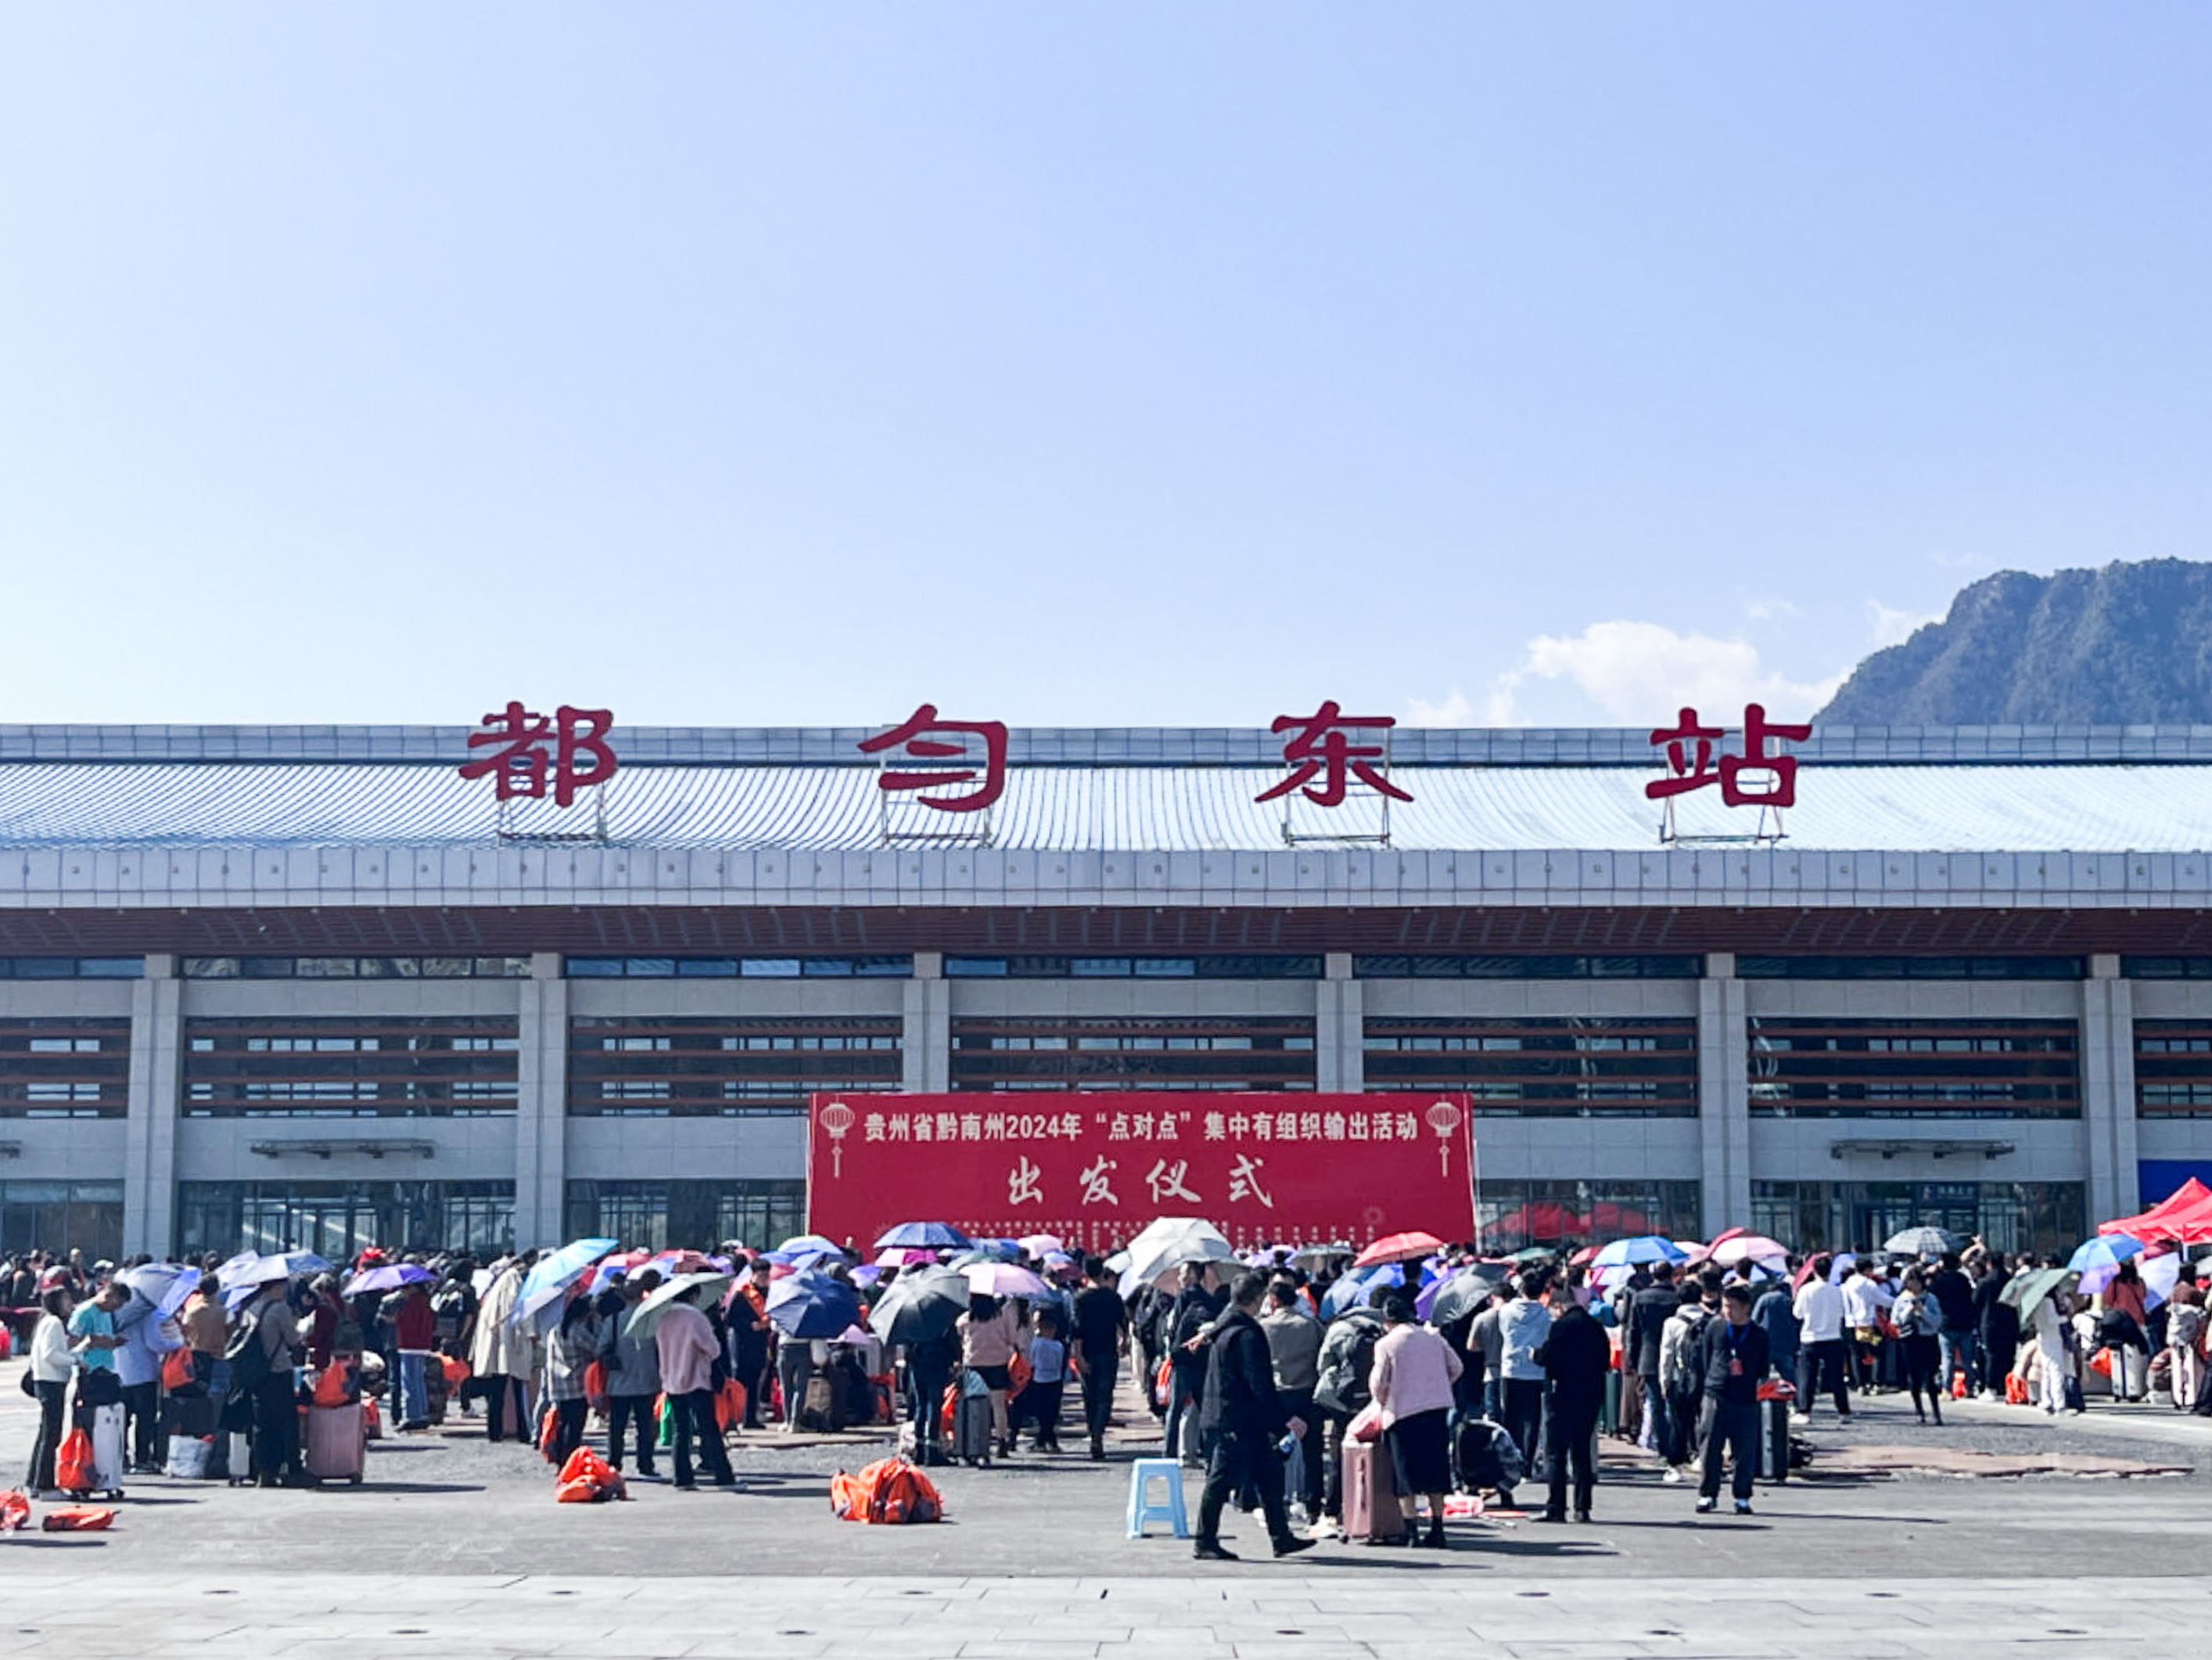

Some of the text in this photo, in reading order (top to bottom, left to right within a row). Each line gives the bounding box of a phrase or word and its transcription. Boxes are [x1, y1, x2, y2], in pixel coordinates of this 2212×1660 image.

[458, 701, 1812, 813] 都匀东站
[1008, 1153, 1274, 1208] 出发仪式
